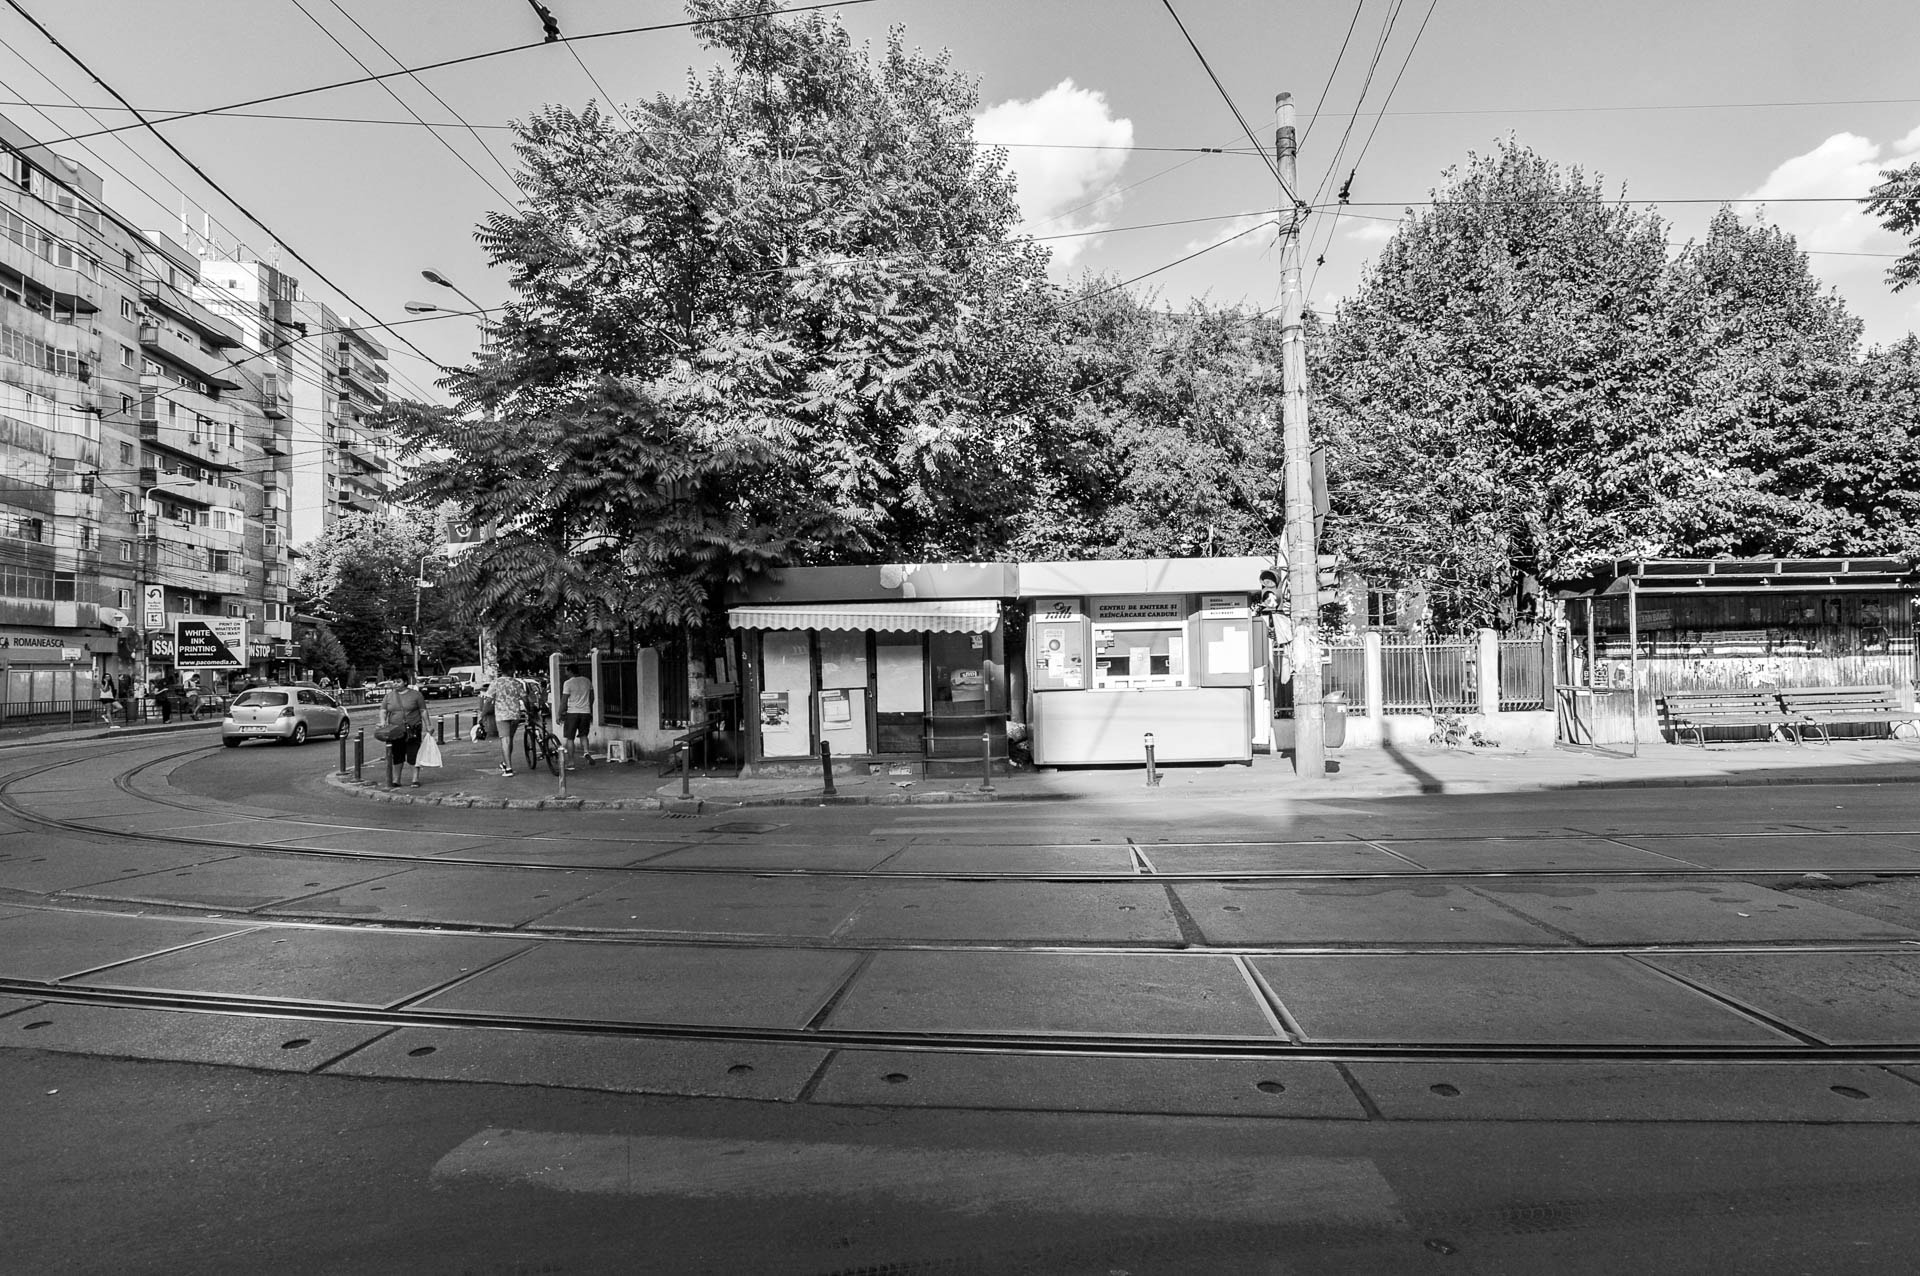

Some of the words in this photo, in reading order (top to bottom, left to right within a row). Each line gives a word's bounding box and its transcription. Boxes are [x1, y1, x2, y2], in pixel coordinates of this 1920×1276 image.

[184, 629, 211, 637] WHITE
[13, 637, 64, 648] ROMANEASCA
[190, 637, 205, 645] INK
[152, 640, 174, 656] ISSA
[179, 645, 217, 653] PRINTING
[255, 644, 271, 658] STOP
